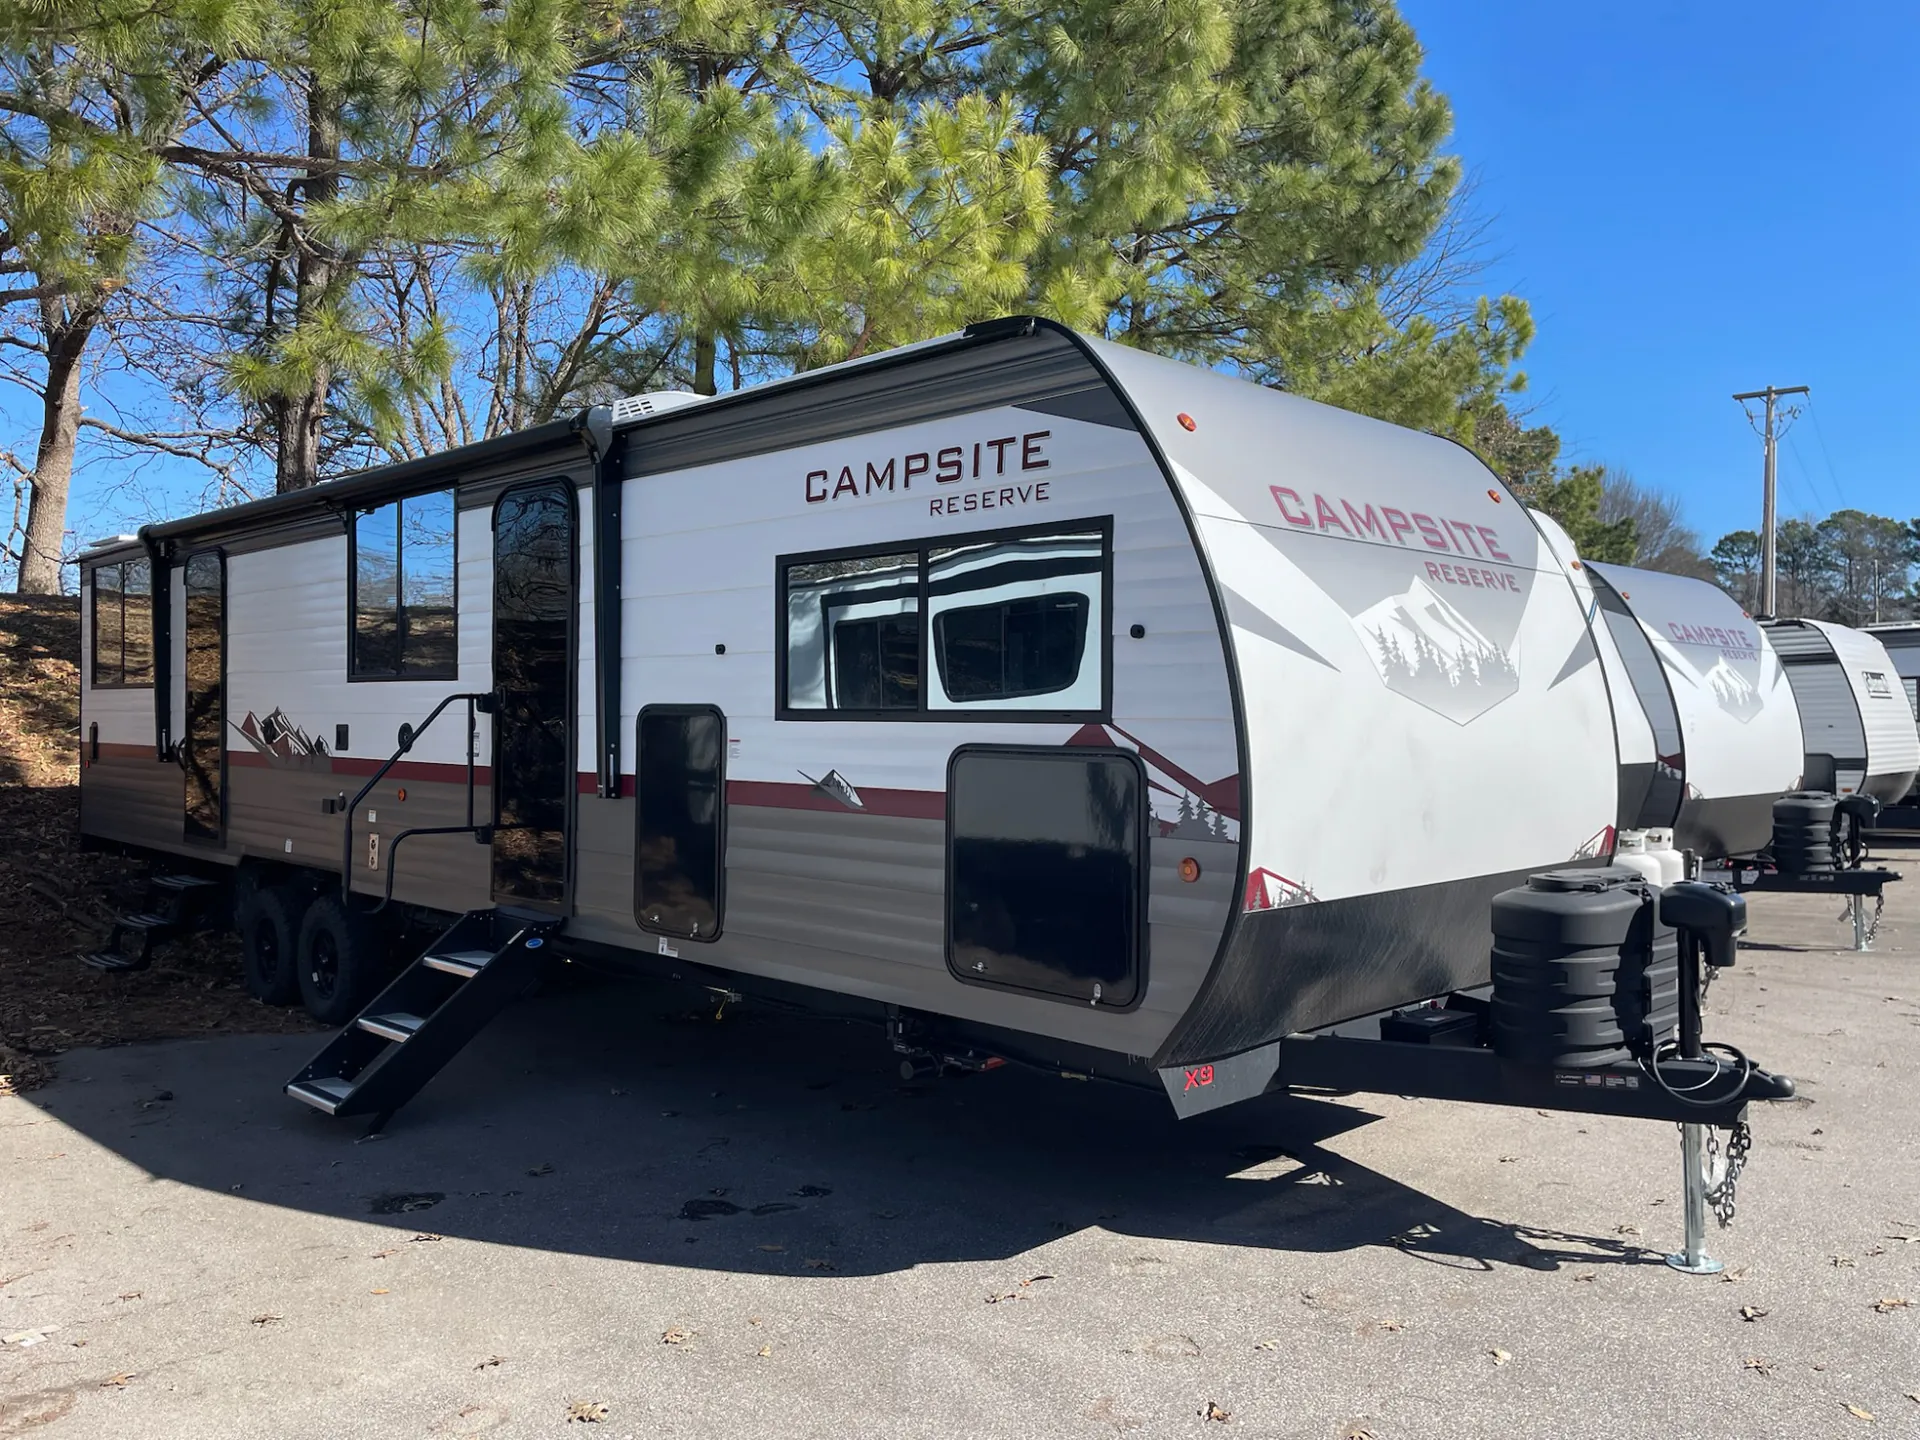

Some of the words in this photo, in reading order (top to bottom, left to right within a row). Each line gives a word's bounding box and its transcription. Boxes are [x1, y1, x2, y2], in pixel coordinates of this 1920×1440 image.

[805, 430, 1051, 503] CAMPSITE
[929, 482, 1050, 516] RESERVE
[1269, 484, 1512, 562] CAMPSITE
[1424, 561, 1521, 593] RESERVE
[1667, 622, 1753, 648] CAMPSITE
